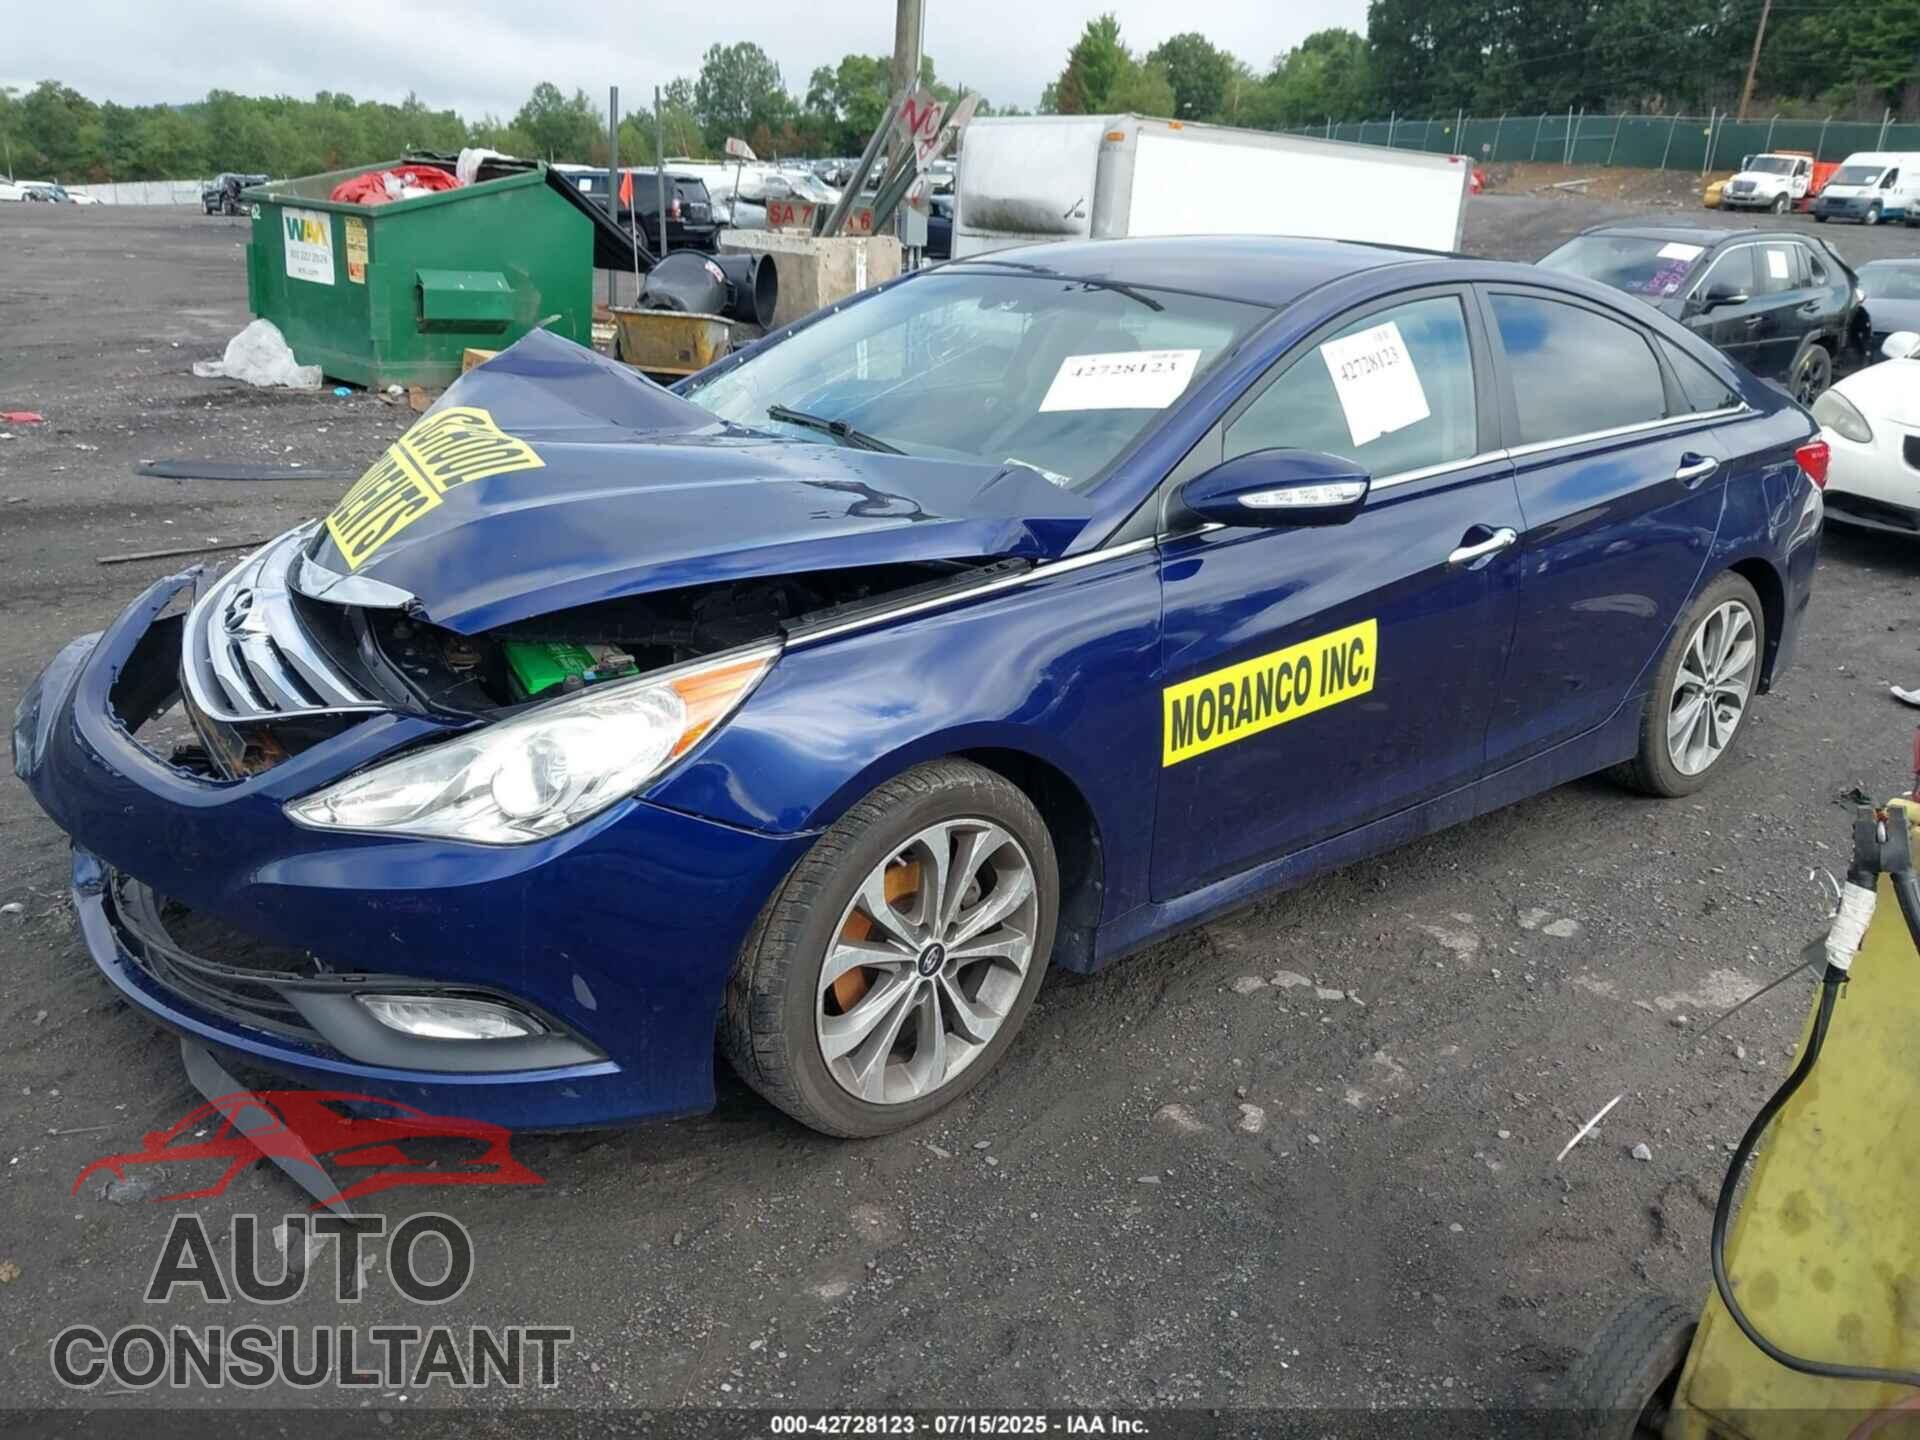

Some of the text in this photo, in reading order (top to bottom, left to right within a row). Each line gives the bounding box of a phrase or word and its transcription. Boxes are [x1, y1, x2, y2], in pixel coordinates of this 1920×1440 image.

[770, 204, 813, 225] SA 7
[860, 208, 873, 230] 6
[1071, 361, 1177, 377] 42728123
[1341, 345, 1400, 382] 42728123
[1171, 637, 1370, 752] MORANCO INC.
